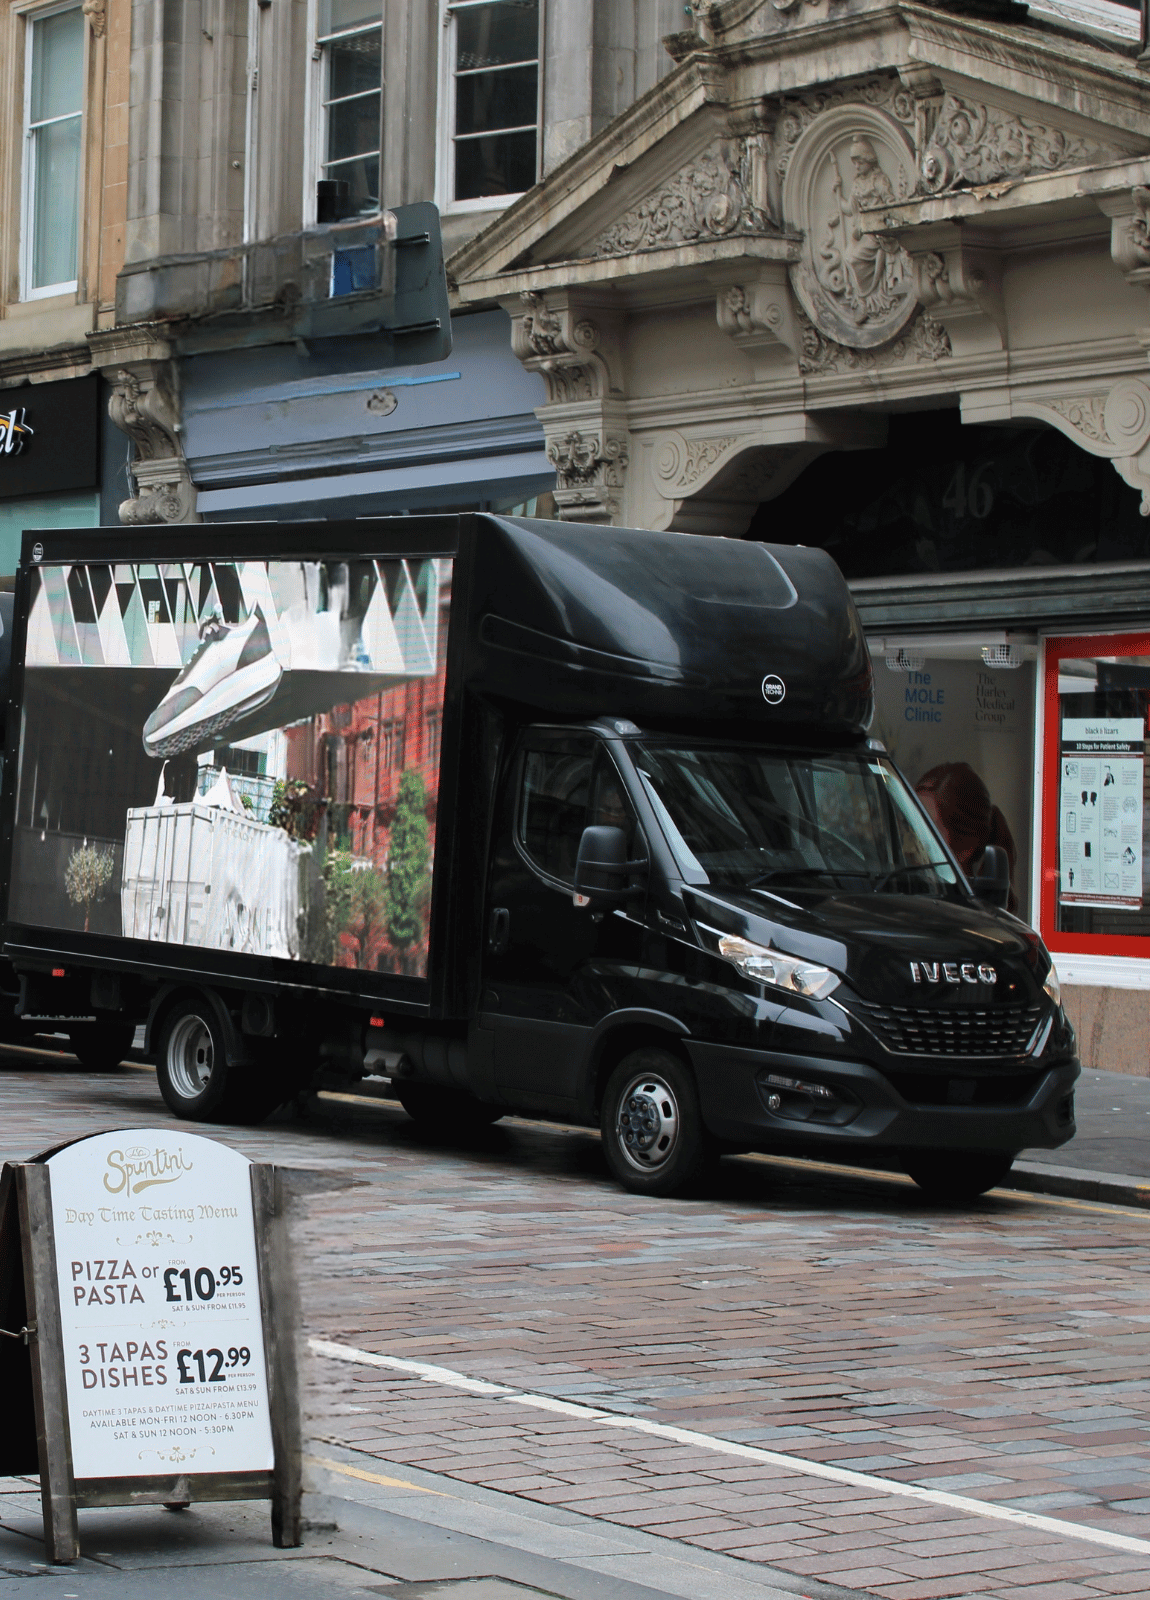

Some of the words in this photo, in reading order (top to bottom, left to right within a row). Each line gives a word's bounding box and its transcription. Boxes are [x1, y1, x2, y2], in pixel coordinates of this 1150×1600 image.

[942, 461, 995, 518] 46
[908, 671, 931, 685] The
[976, 672, 996, 685] The
[905, 688, 945, 705] MOLE
[976, 685, 1007, 698] Harley
[976, 697, 1015, 711] Medical
[904, 706, 942, 723] Clinic
[975, 710, 1006, 725] Group
[1116, 742, 1131, 751] Safety
[910, 962, 997, 985] IVECO
[103, 1147, 193, 1198] Spuntini
[65, 1208, 95, 1226] Day
[98, 1206, 136, 1223] Time
[139, 1204, 195, 1223] Tasting
[197, 1204, 239, 1220] Menu
[71, 1259, 137, 1281] PIZZA
[141, 1266, 159, 1279] or
[163, 1265, 244, 1302] £10.95
[73, 1284, 145, 1306] PASTA
[185, 1304, 190, 1312] &
[78, 1344, 90, 1364] 3
[96, 1340, 168, 1363] TAPAS
[176, 1346, 251, 1384] £12.99
[81, 1365, 168, 1389] DISHES
[175, 1387, 188, 1395] SAT
[195, 1386, 212, 1394] SUN
[213, 1385, 235, 1393] FROM
[236, 1384, 257, 1392] £13.99
[82, 1409, 116, 1418] DAYTIME
[124, 1407, 147, 1415] TAPAS
[155, 1405, 188, 1413] DAYTIME
[189, 1401, 235, 1411] PIZZA/PASTA
[237, 1400, 259, 1408] MENU
[90, 1417, 137, 1428] AVAILABLE
[139, 1416, 178, 1425] MON-FRI
[179, 1415, 188, 1423] 12
[189, 1414, 217, 1422] NOON
[224, 1411, 255, 1420] 6.30PM
[113, 1431, 128, 1440] SAT
[131, 1431, 137, 1439] &
[139, 1430, 157, 1439] SUN
[159, 1429, 168, 1437] 12
[169, 1427, 197, 1436] NOON
